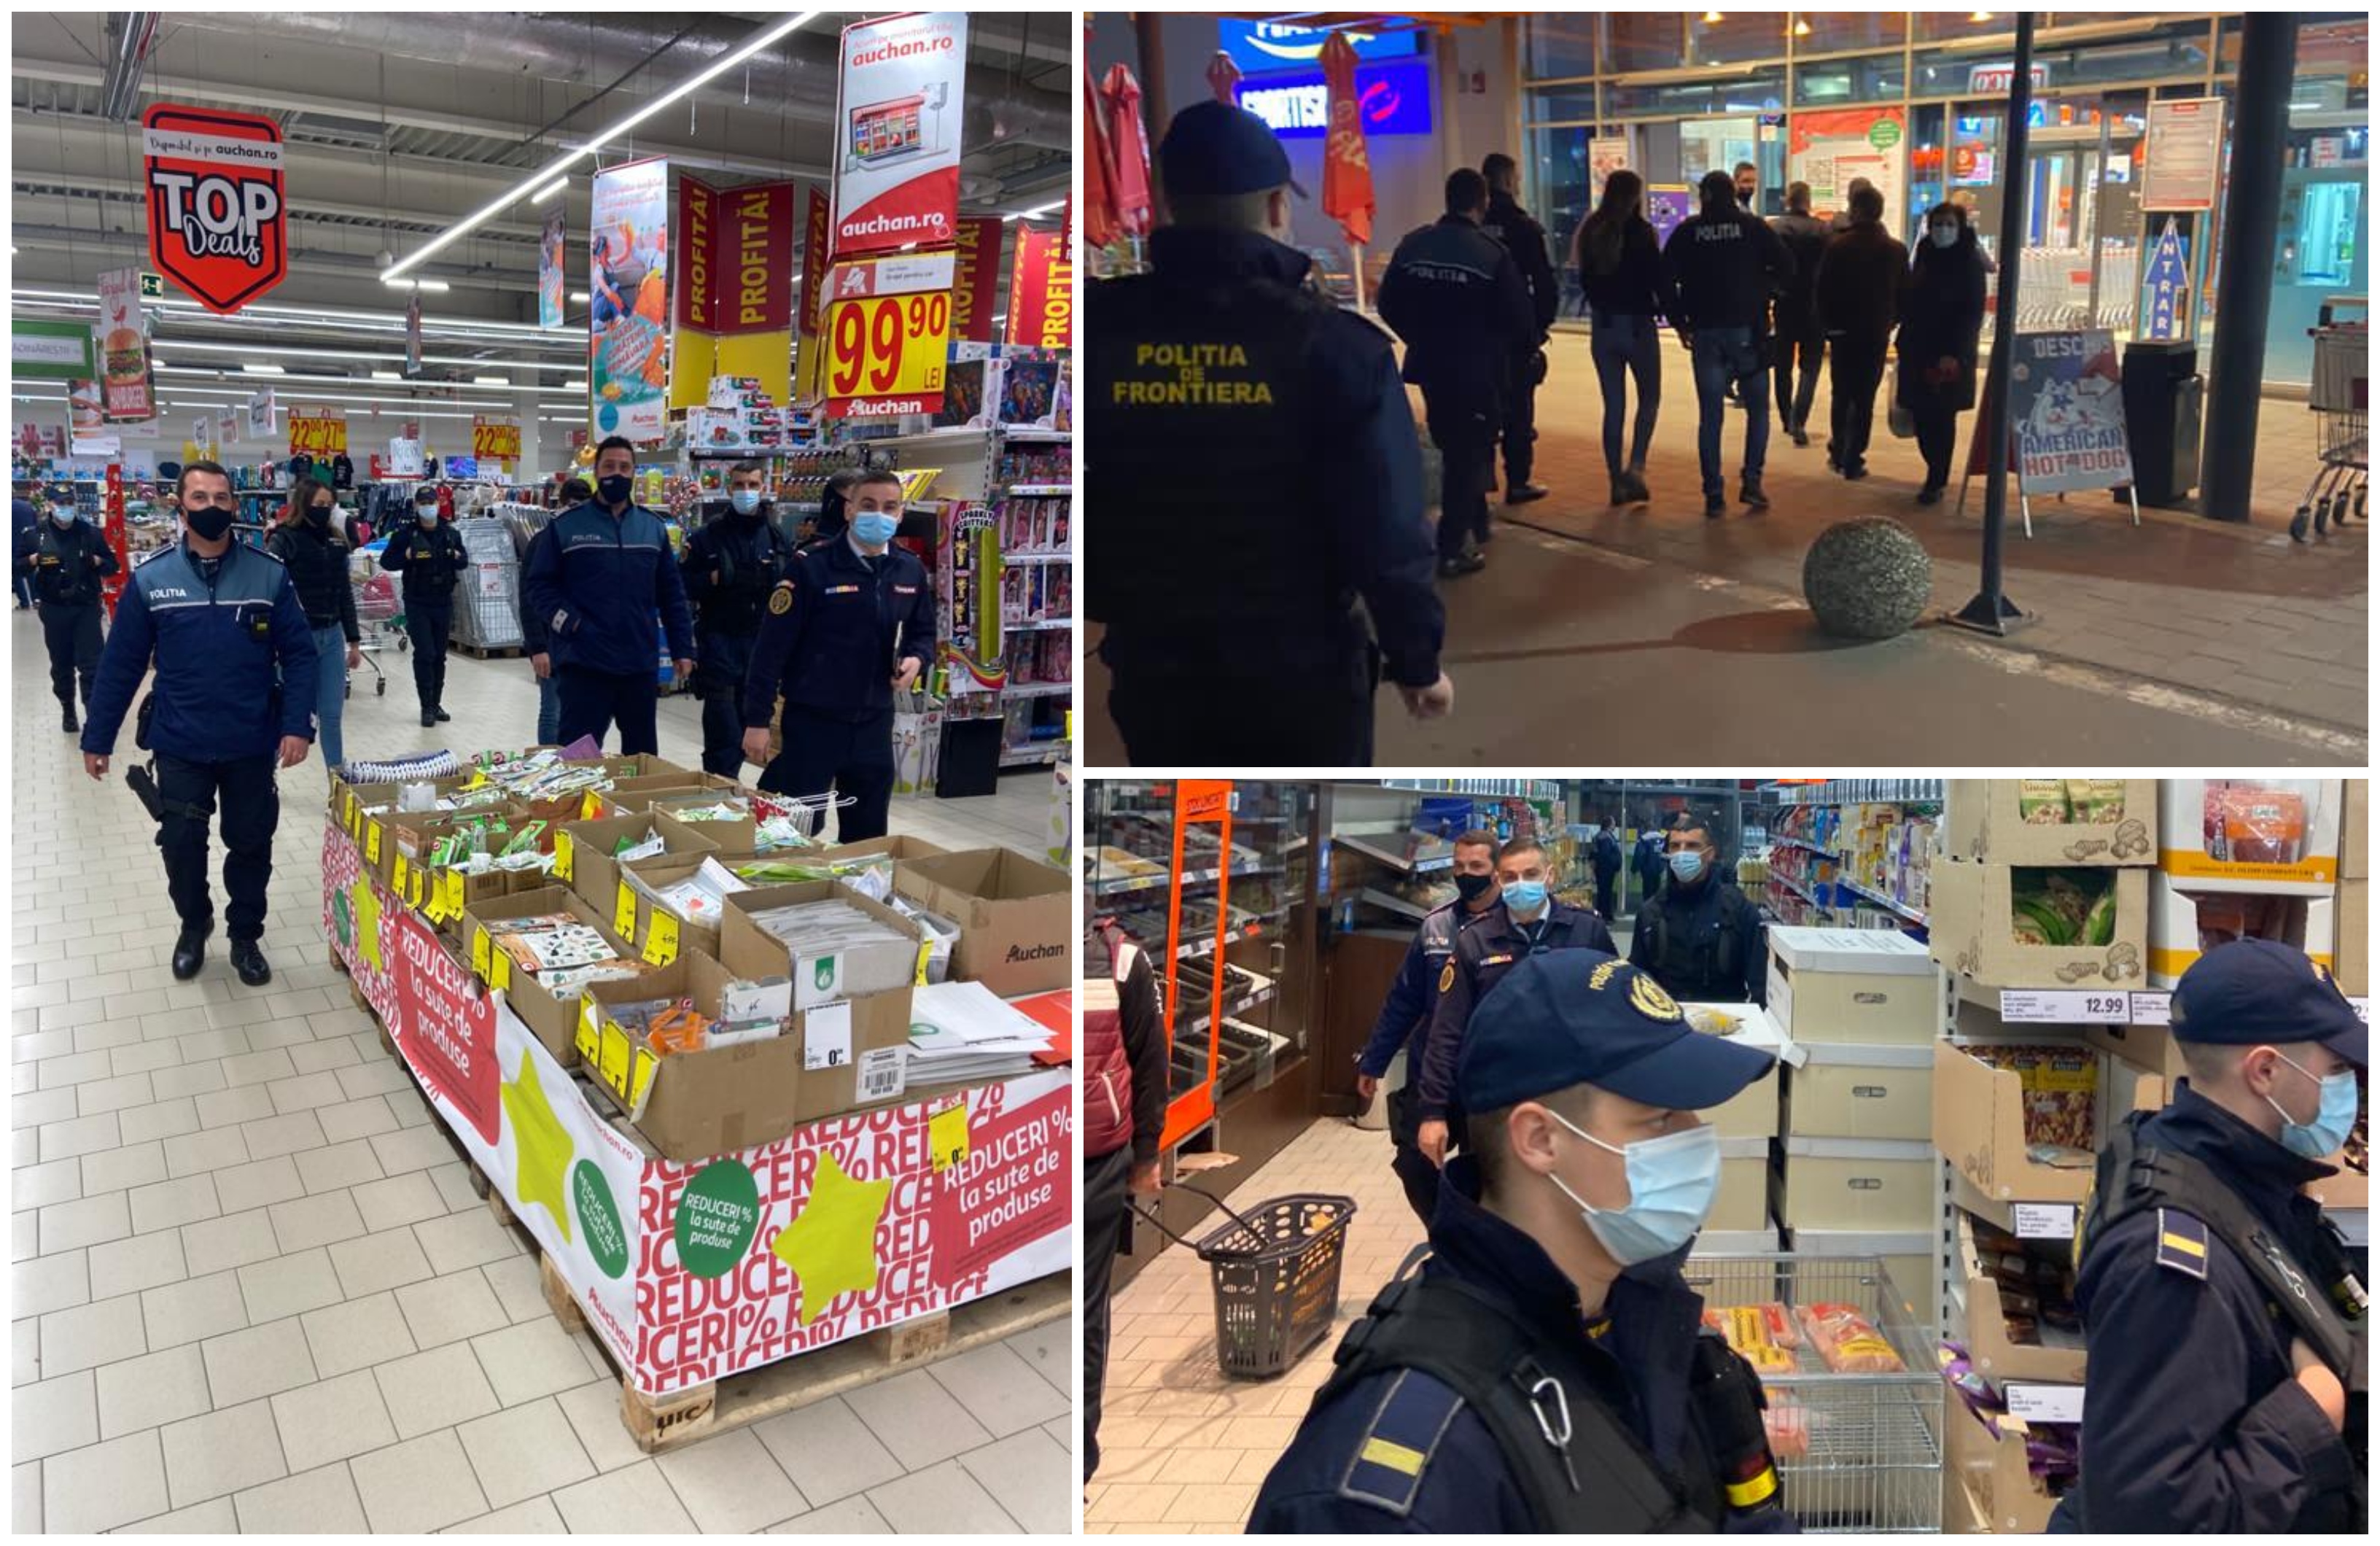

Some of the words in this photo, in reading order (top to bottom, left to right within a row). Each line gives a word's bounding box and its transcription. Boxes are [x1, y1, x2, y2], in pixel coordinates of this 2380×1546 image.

[852, 36, 953, 67] auchan.ro
[216, 144, 278, 160] auchan.ro
[152, 172, 278, 237] TOP
[183, 214, 261, 265] Deals
[842, 211, 944, 238] auchan.ro
[1696, 223, 1742, 242] POLITIA
[736, 191, 769, 324] PROFITĂ!
[2156, 221, 2175, 339] INTRAR
[833, 298, 903, 395] 99
[908, 294, 946, 339] 90
[1137, 343, 1248, 366] POLITIA
[924, 368, 941, 389] LEI
[1180, 368, 1205, 383] DE
[847, 398, 922, 417] Auchan
[1113, 381, 1272, 403] FRONTIERA
[2023, 427, 2123, 454] AMERICAN
[402, 925, 467, 1005] REDUCERI
[1006, 943, 1065, 963] Auchan
[410, 963, 424, 998] la
[425, 985, 454, 1026] sute
[454, 1007, 473, 1046] de
[2085, 998, 2123, 1014] 12.99
[417, 1009, 471, 1079] produse
[944, 1116, 1049, 1194] REDUCERI
[959, 1186, 981, 1214] la
[984, 1162, 1030, 1202] sute
[1033, 1147, 1059, 1177] de
[685, 1192, 741, 1220] REDUCERI
[741, 1205, 753, 1224] %
[689, 1211, 701, 1227] la
[701, 1216, 726, 1234] sute
[726, 1219, 742, 1236] de
[968, 1183, 1052, 1248] produse
[688, 1230, 733, 1250] produse
[588, 1286, 633, 1356] Auchan
